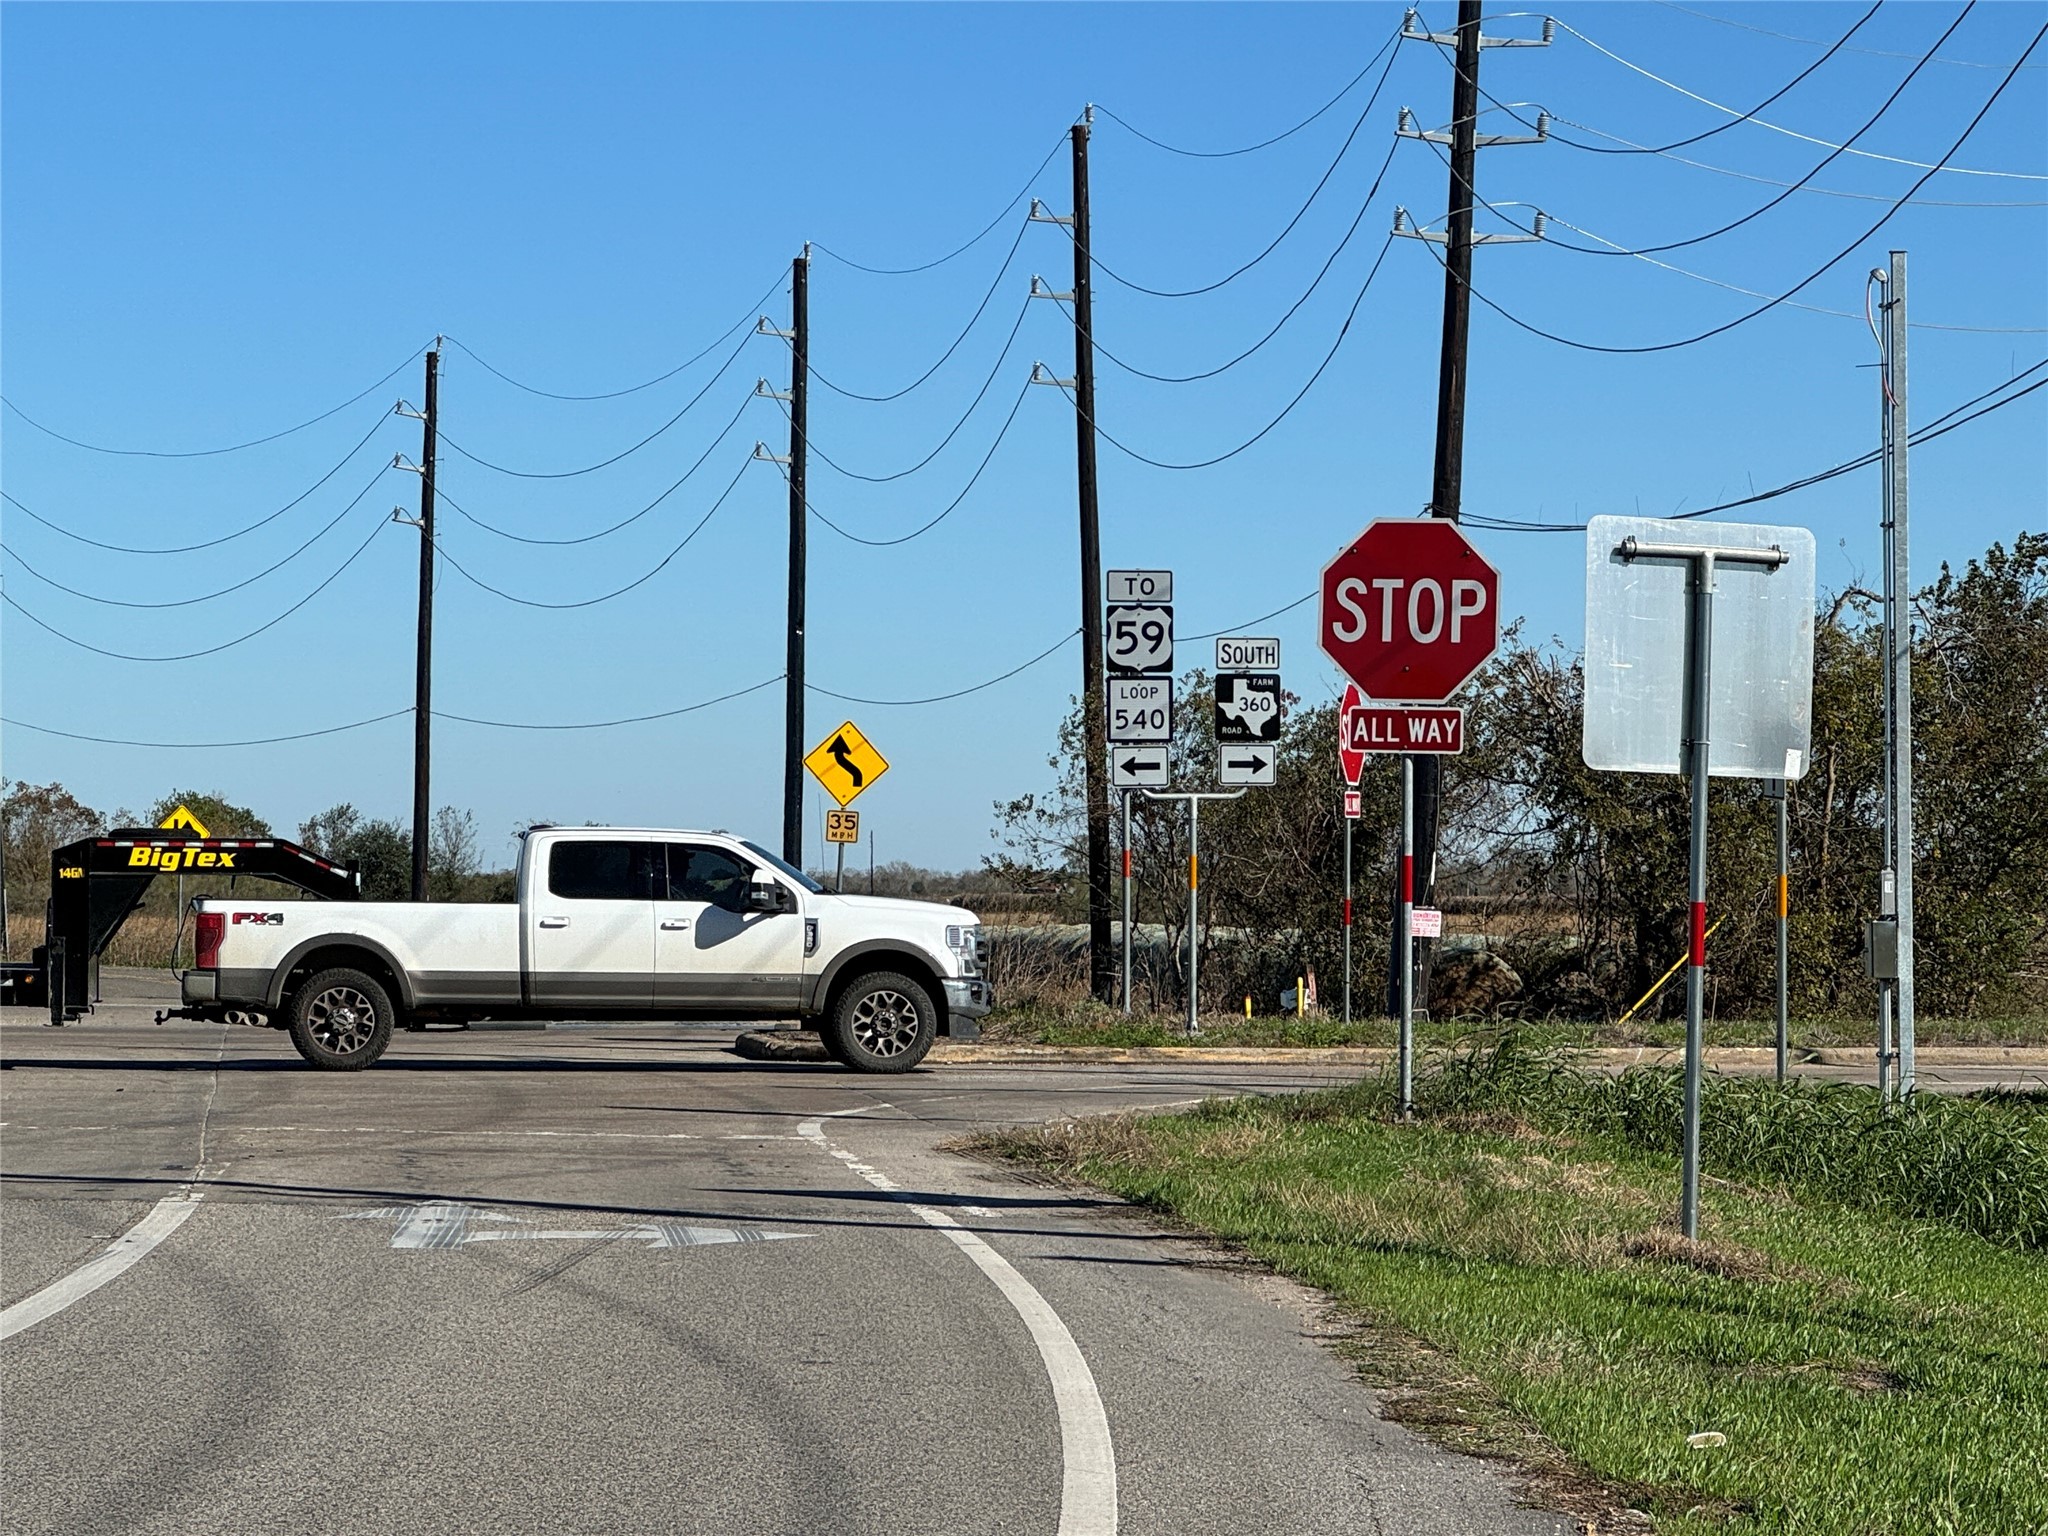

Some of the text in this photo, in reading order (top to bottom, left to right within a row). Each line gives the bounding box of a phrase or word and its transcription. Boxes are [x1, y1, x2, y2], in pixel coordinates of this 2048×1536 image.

[1125, 577, 1155, 596] TO
[1332, 577, 1487, 644] STOP
[1115, 620, 1165, 656] 59
[1220, 643, 1276, 665] SOUTH
[1252, 678, 1274, 686] FARM
[1120, 686, 1159, 699] LOOP
[1239, 696, 1271, 712] 360
[1115, 709, 1165, 730] 540
[1221, 726, 1242, 734] ROAD
[1353, 717, 1400, 743] ALL
[1408, 717, 1458, 744] WAY
[829, 813, 856, 831] 35
[831, 831, 854, 840] MPH
[232, 912, 285, 926] FX4
